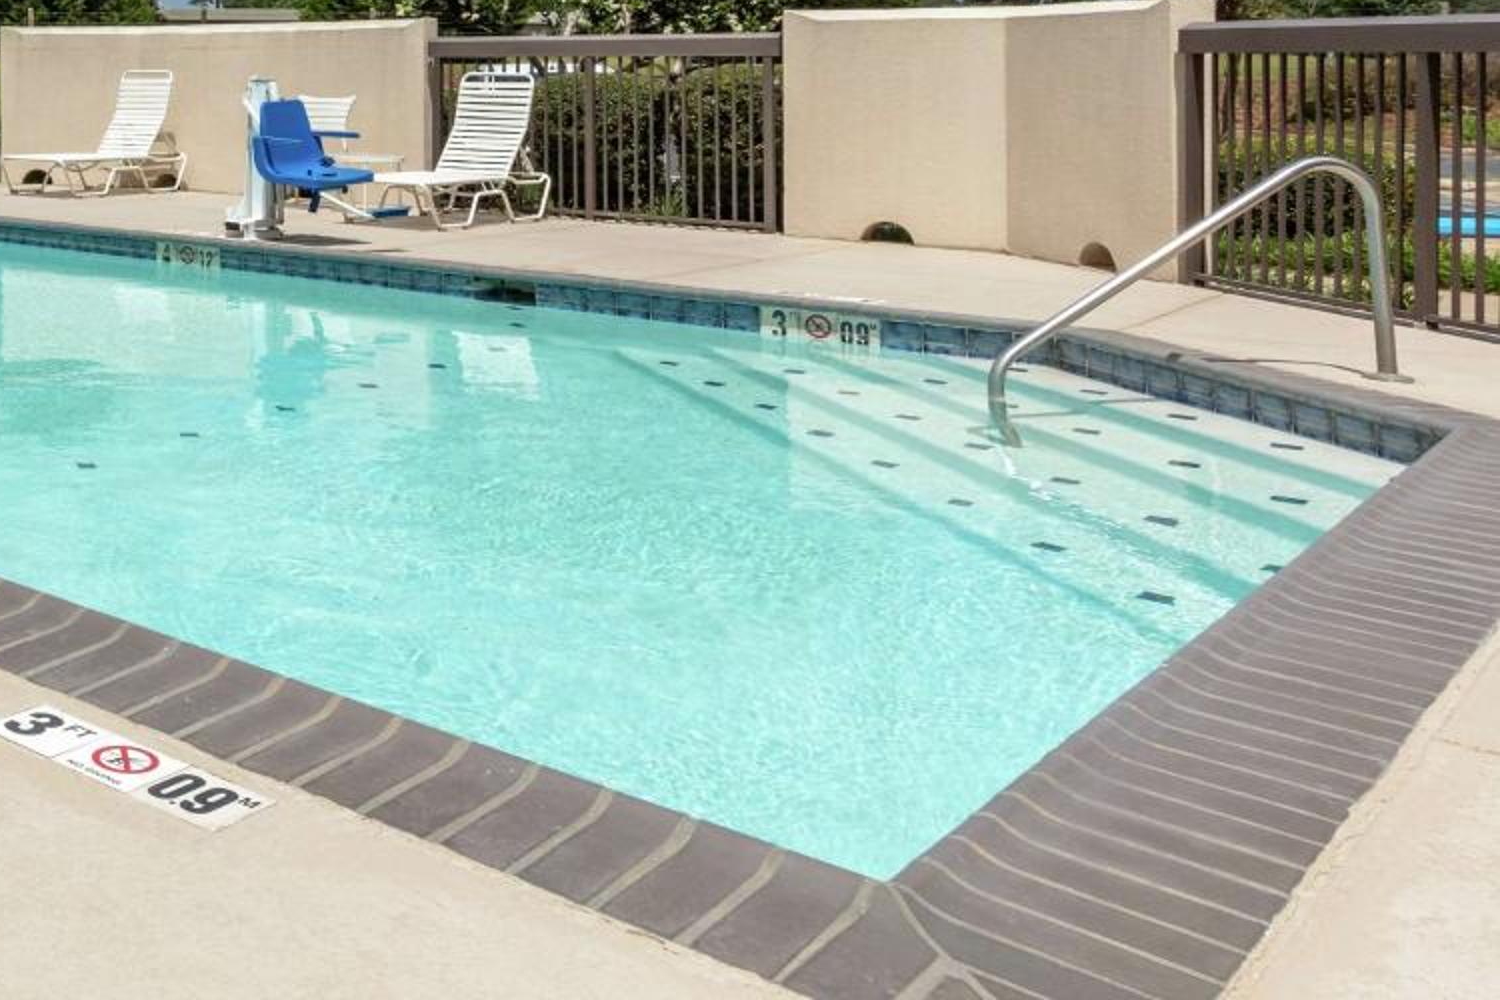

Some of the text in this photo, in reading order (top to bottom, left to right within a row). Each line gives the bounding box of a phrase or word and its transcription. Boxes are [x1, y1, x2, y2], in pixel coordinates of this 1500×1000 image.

[771, 309, 787, 337] 3
[3, 711, 65, 736] 3
[64, 723, 98, 739] FT
